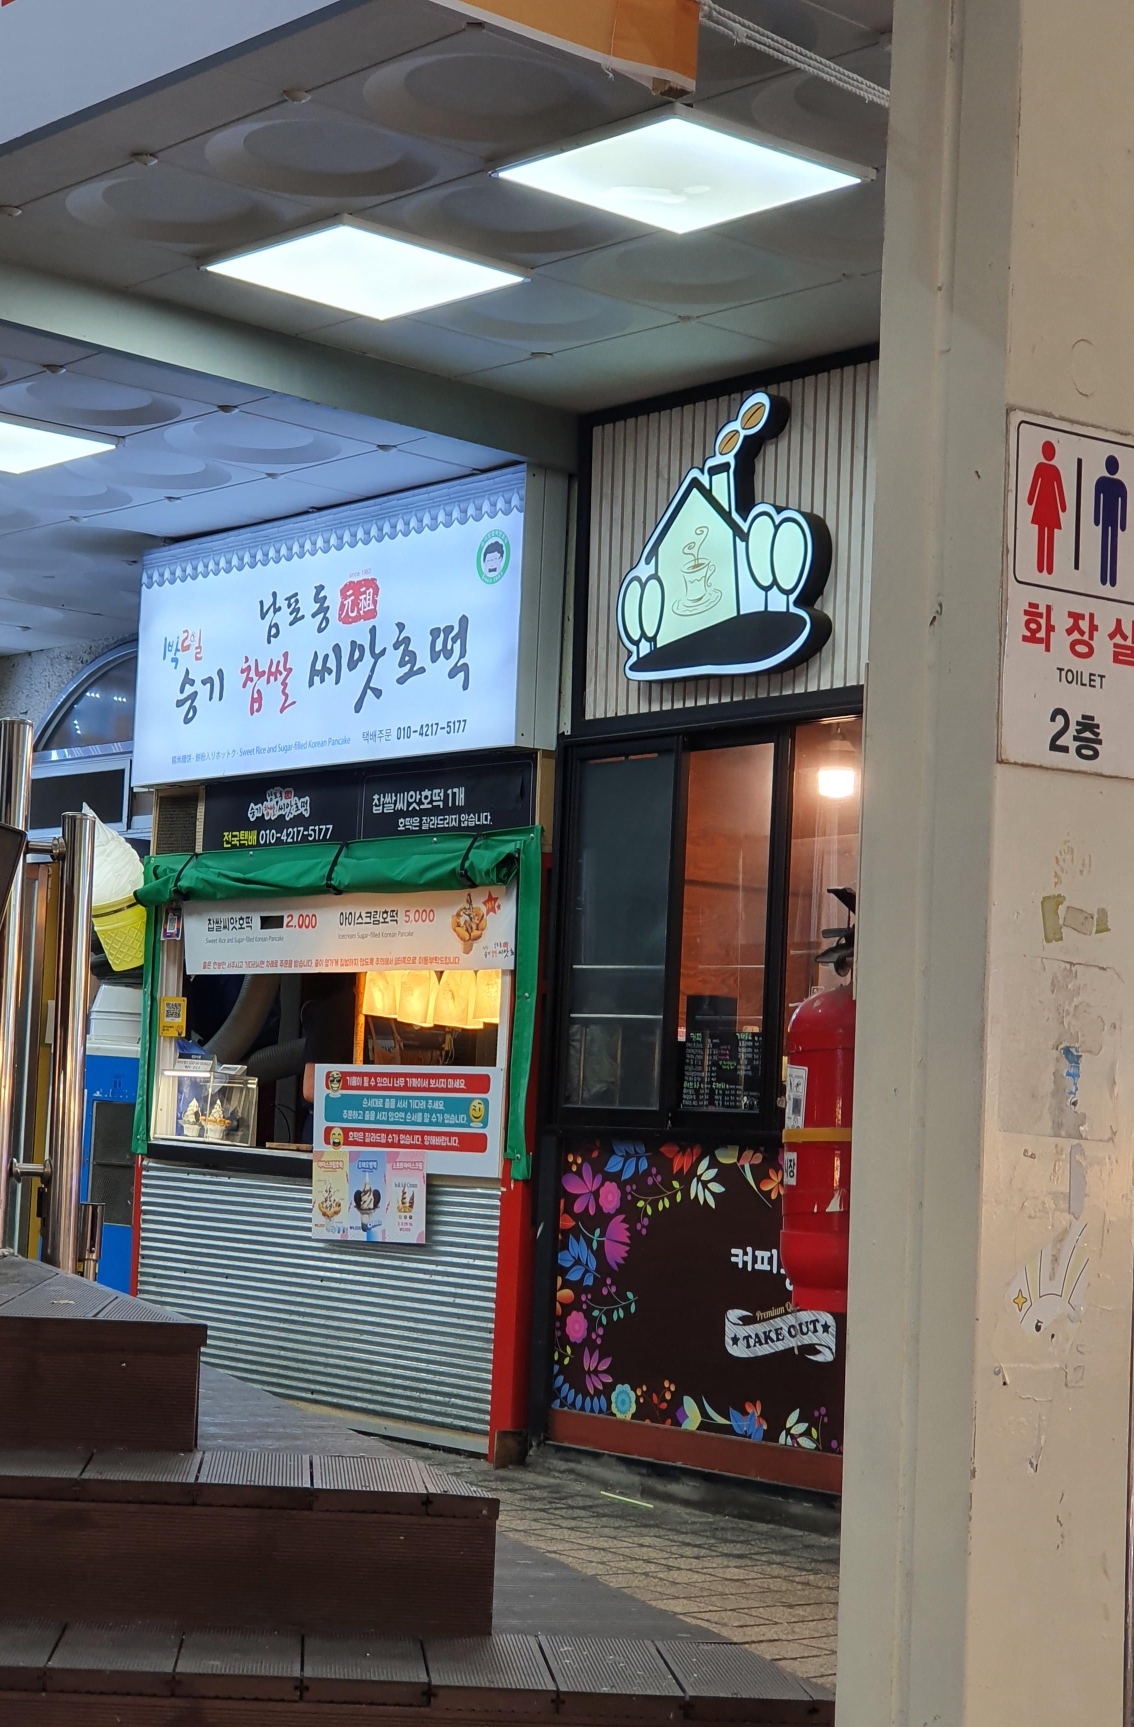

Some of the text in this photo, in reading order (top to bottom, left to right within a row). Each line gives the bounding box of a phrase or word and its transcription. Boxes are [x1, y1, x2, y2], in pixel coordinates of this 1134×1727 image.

[259, 584, 375, 645] 남포동 元祖
[1021, 601, 1134, 667] 화장실
[163, 628, 203, 670] 1박2일
[175, 613, 470, 725] 승기 찹쌀 씨앗호떡
[1056, 667, 1106, 690] TOILET
[362, 718, 468, 744] 택배주문 010-4217-5177
[1048, 707, 1103, 762] 2층
[240, 735, 351, 757] Sweet Rice and Sugar-filled Korean Pancake
[372, 786, 465, 813] 찹쌀씨앗호떡 1개
[397, 812, 493, 830] 호떡은 잘라드리지 않습니다.
[223, 825, 333, 848] 전국택배 010-4217-5177
[207, 916, 253, 932] 찹쌀씨앗호떡
[339, 909, 435, 926] 아이스크림호떡 5,000
[234, 936, 254, 945] Sugar-filled
[338, 932, 356, 940] Icecream
[357, 931, 380, 940] Sugar-filled
[398, 930, 414, 938] Pancake
[346, 1076, 362, 1086] 기름이
[370, 1078, 375, 1086] 수
[377, 1077, 393, 1087] 있으니
[394, 1078, 405, 1087] 너무
[406, 1078, 428, 1088] 가까이서
[429, 1079, 446, 1088] 보시지
[362, 1098, 383, 1108] 순서대로
[385, 1098, 395, 1108] 줄을
[397, 1099, 407, 1109] 서서
[409, 1099, 426, 1109] 기다려
[343, 1110, 468, 1124] 주문하고 줄을 서지 않으면 순서를 알 수가 없습니다.
[348, 1132, 364, 1142] 호떡은
[387, 1133, 398, 1143] 수가
[400, 1134, 422, 1144] 없습니다.
[730, 1246, 793, 1291] 커피
[756, 1306, 785, 1321] Premium
[743, 1318, 820, 1349] TAKE OUT
